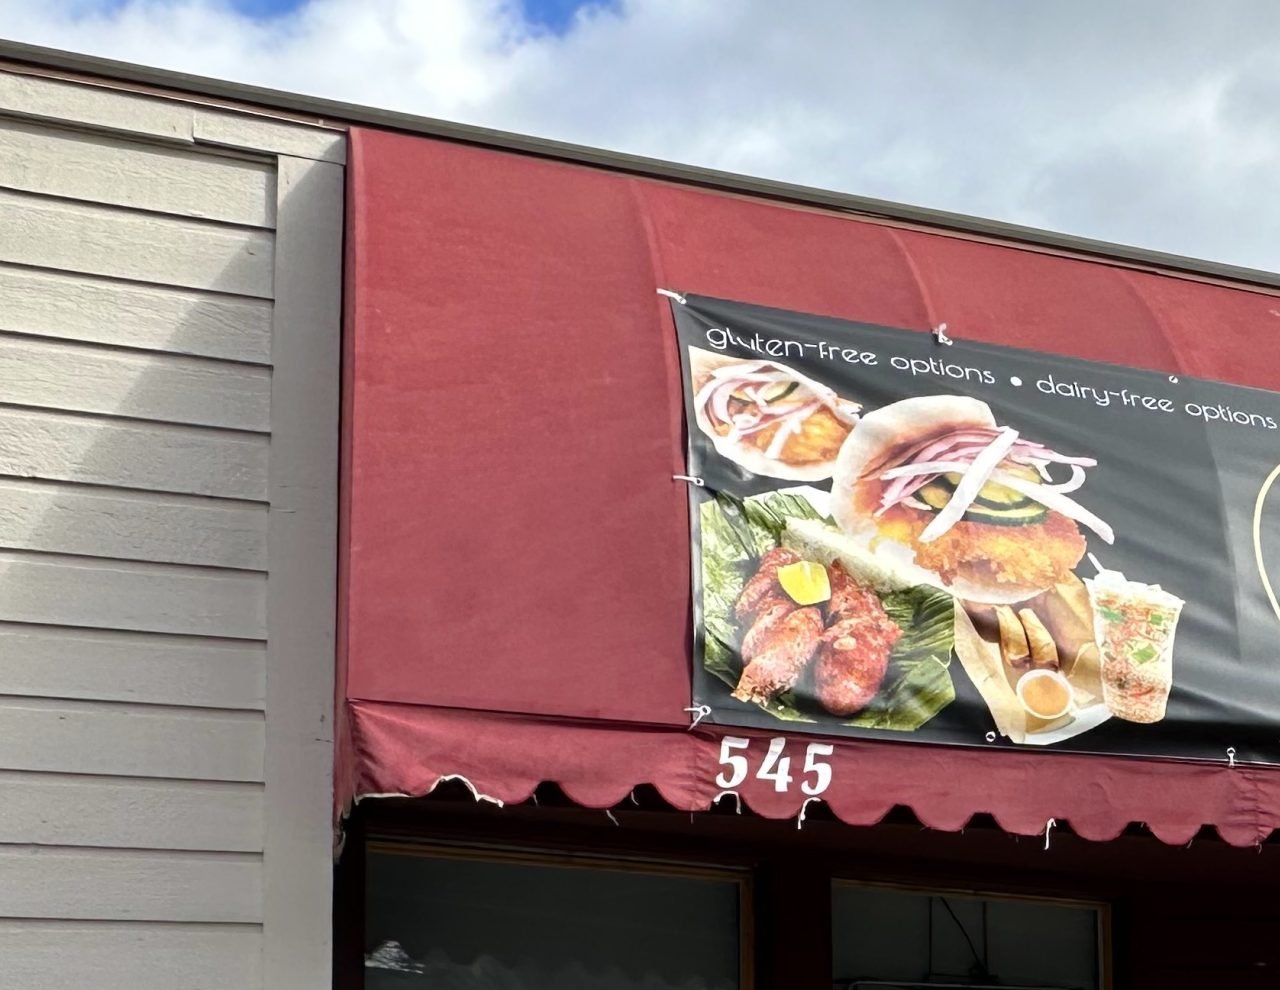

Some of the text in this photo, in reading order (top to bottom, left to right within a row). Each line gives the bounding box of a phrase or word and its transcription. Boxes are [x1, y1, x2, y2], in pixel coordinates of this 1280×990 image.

[705, 327, 996, 385] gluten-free options
[1036, 374, 1278, 430] dairy-free options
[715, 735, 834, 796] 545
